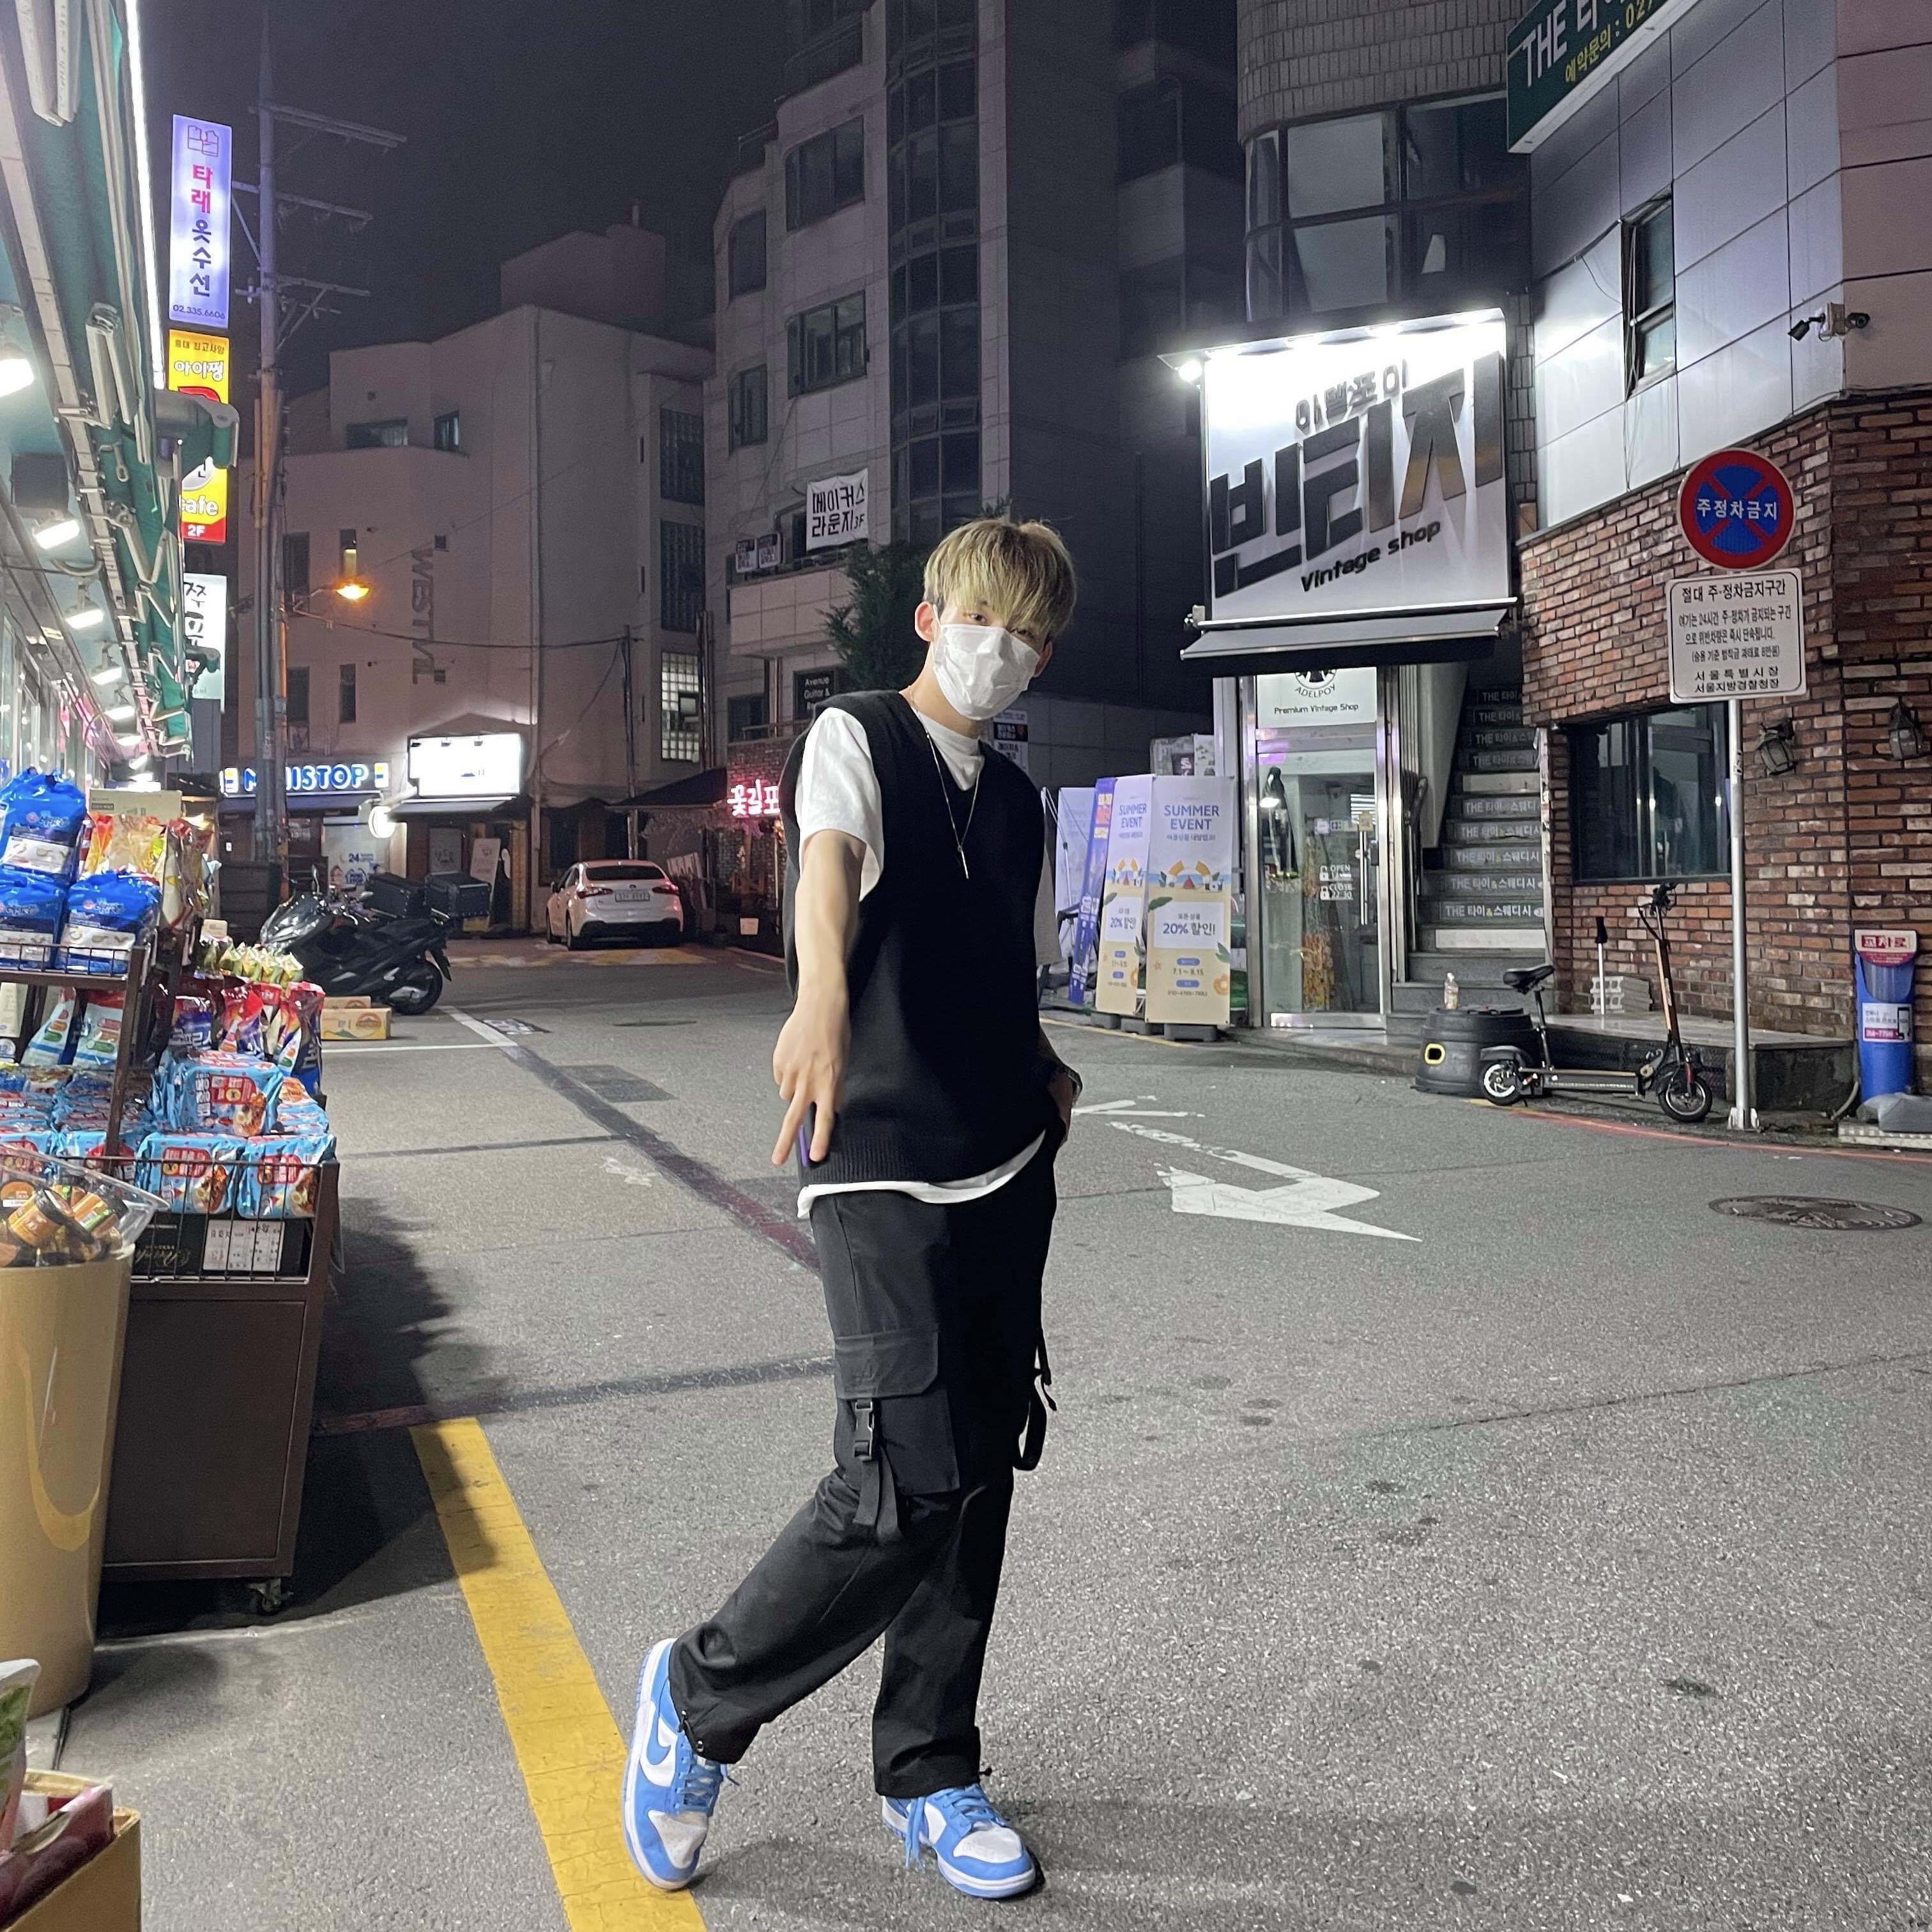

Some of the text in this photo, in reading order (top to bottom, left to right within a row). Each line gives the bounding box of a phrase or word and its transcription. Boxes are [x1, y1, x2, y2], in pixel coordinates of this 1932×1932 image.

[1521, 1, 1567, 88] THE
[1565, 24, 1611, 82] 예약문의
[189, 164, 213, 297] 타래 옷수선
[1210, 350, 1504, 599] 빈티지
[812, 482, 865, 514] 메이커스
[1697, 498, 1778, 521] 주정차금지
[811, 510, 865, 537] 라운지 3F
[187, 525, 206, 537] 2F
[1300, 520, 1441, 593] Vintage shop
[1682, 586, 1704, 604] 절대
[1777, 604, 1791, 620] 구간
[805, 677, 829, 687] Avenue
[1294, 682, 1336, 698] ADELPOY
[1482, 692, 1500, 702] THE
[1274, 703, 1359, 715] Premium Vintage Shop
[1479, 712, 1497, 723] THE
[1475, 733, 1493, 745] THE
[1473, 755, 1492, 767] THE
[1119, 802, 1147, 816] SUMMER
[1163, 804, 1220, 816] SUMMER
[1466, 802, 1483, 813] THE
[1121, 816, 1143, 829] EVENT
[1170, 818, 1213, 831] EVENT
[1461, 827, 1479, 838] THE
[1455, 851, 1475, 863] THE
[1450, 878, 1471, 889] THE
[1445, 905, 1466, 917] THE
[1163, 923, 1188, 935] 20%
